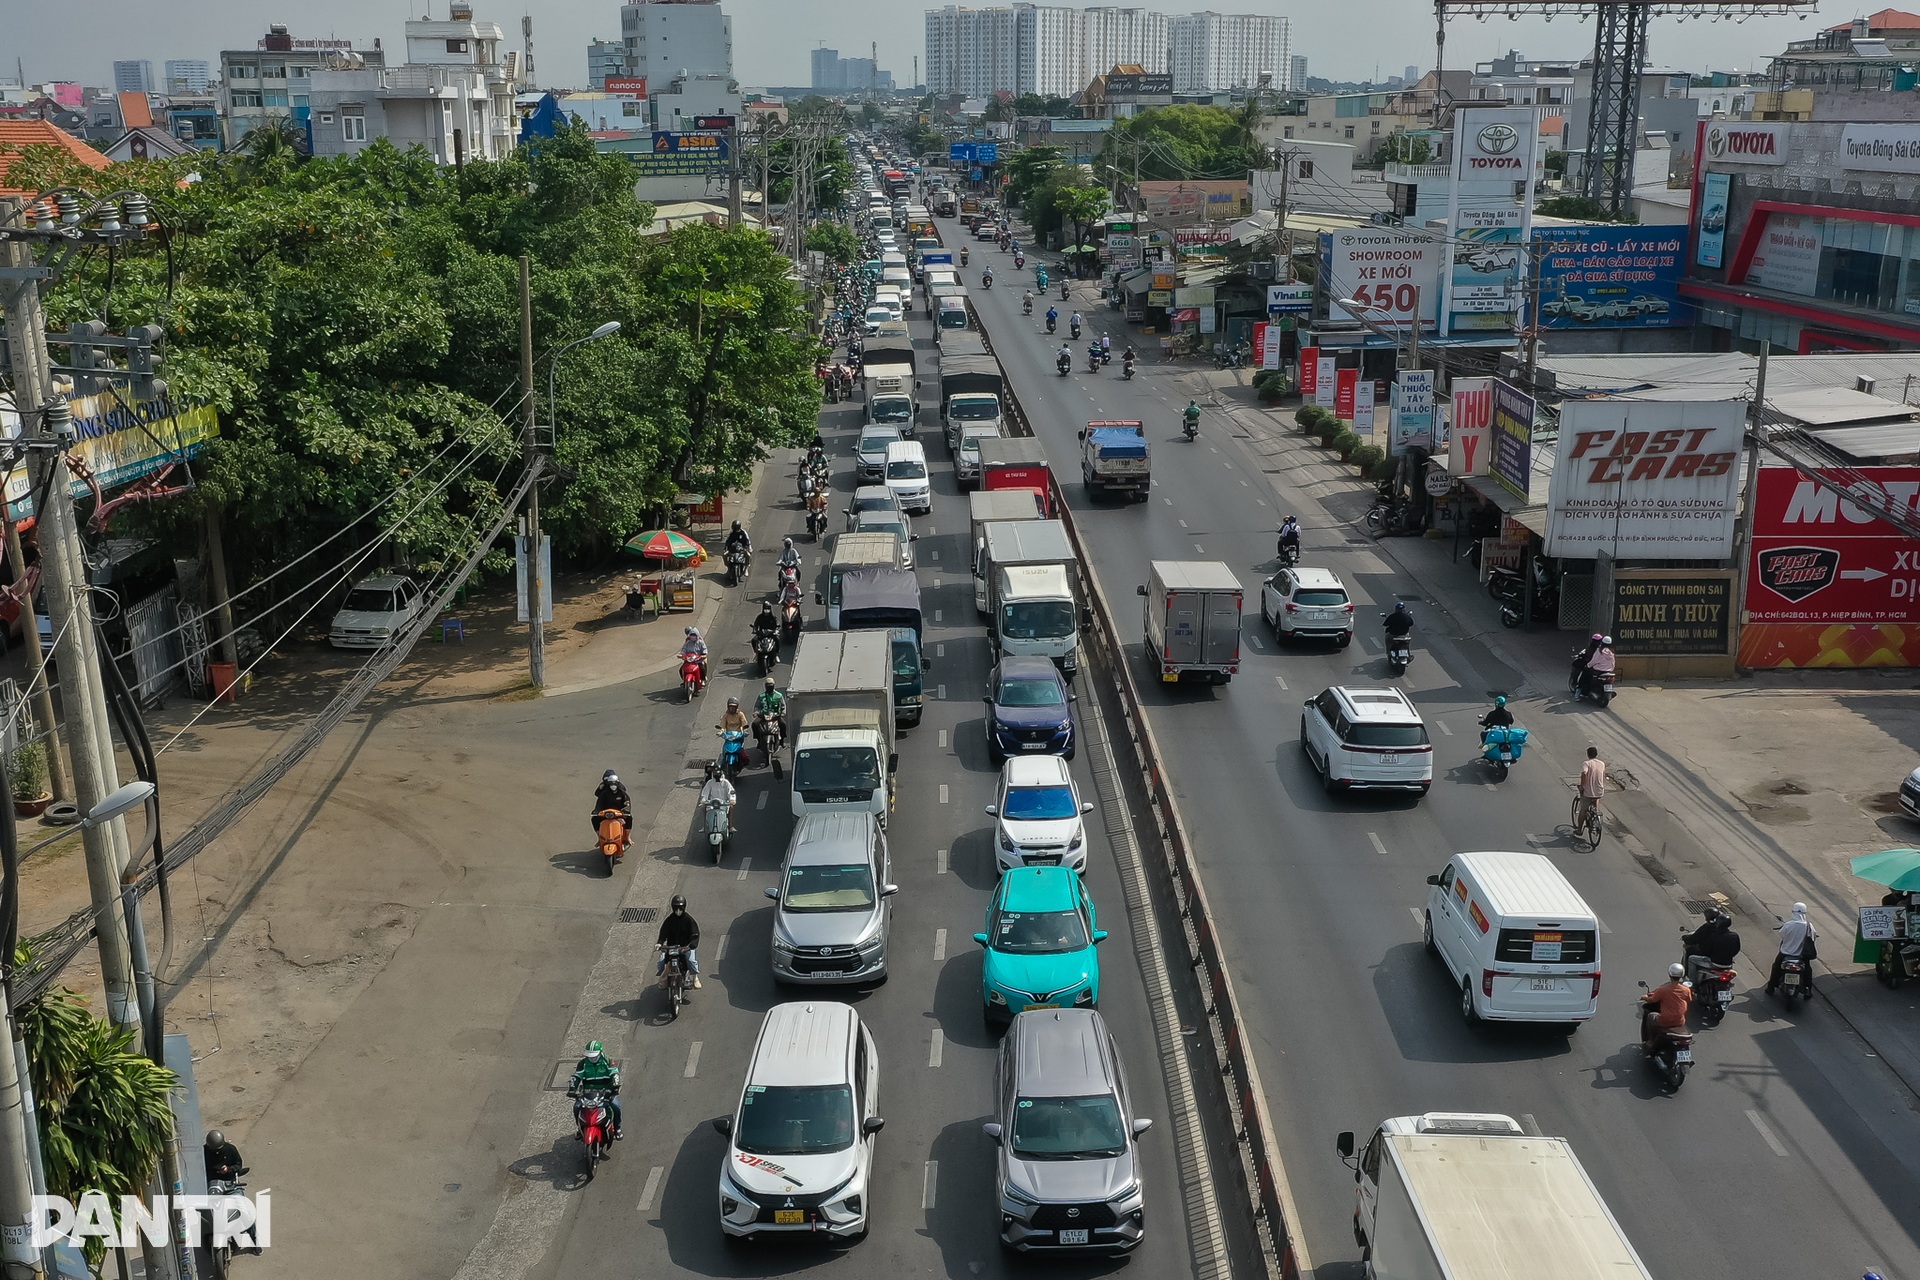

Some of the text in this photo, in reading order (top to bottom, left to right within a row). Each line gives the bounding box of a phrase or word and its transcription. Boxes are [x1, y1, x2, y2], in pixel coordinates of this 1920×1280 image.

[678, 136, 717, 147] ASIA
[1728, 132, 1776, 155] TOYOTA
[1846, 138, 1871, 159] Toyota
[1873, 140, 1893, 161] Đông
[1895, 140, 1908, 158] Sài
[1470, 158, 1522, 168] TOYOTA
[1357, 234, 1433, 245] TOYOTA THỦ ĐỨC
[1574, 241, 1587, 252] XE
[1591, 240, 1607, 252] CŨ
[1617, 239, 1637, 252] LẤY
[1641, 242, 1654, 252] XE
[1657, 239, 1680, 251] MỚI
[1349, 250, 1422, 262] SHOWROOM
[1583, 256, 1605, 267] BÁN
[1607, 256, 1632, 267] CÁC
[1634, 257, 1658, 267] LOẠI
[1660, 256, 1674, 266] XE
[1358, 264, 1411, 280] XE MỚI
[1567, 270, 1656, 283] ĐÃ QUA SỬ DỤNG
[1352, 284, 1416, 313] 650
[1407, 373, 1425, 382] NHÀ
[1401, 383, 1431, 392] THUỐC
[1407, 394, 1425, 403] TÂY
[1401, 404, 1430, 414] BÁ LỘC
[1455, 382, 1491, 429] THÚ
[1569, 428, 1717, 459] FAST
[1461, 435, 1480, 473] Y
[1588, 452, 1736, 484] CARS
[1640, 498, 1654, 507] TÔ
[1657, 500, 1677, 508] QUA
[1695, 500, 1723, 510] DỤNG
[1782, 480, 1920, 524] MOT
[1565, 512, 1590, 520] DỊCH
[1592, 512, 1607, 520] VỤ
[1671, 510, 1692, 519] SỬA
[1767, 553, 1822, 572] FAST
[1774, 566, 1828, 585] CARS
[1620, 583, 1723, 595] CÔNG TY TNHH BON SAI
[1619, 598, 1721, 622] MINH THÙY
[1620, 629, 1635, 639] CHO
[1636, 627, 1654, 639] THUÊ
[1674, 629, 1689, 638] MUA
[1703, 626, 1718, 638] BÁN
[760, 1161, 786, 1172] SPEED
